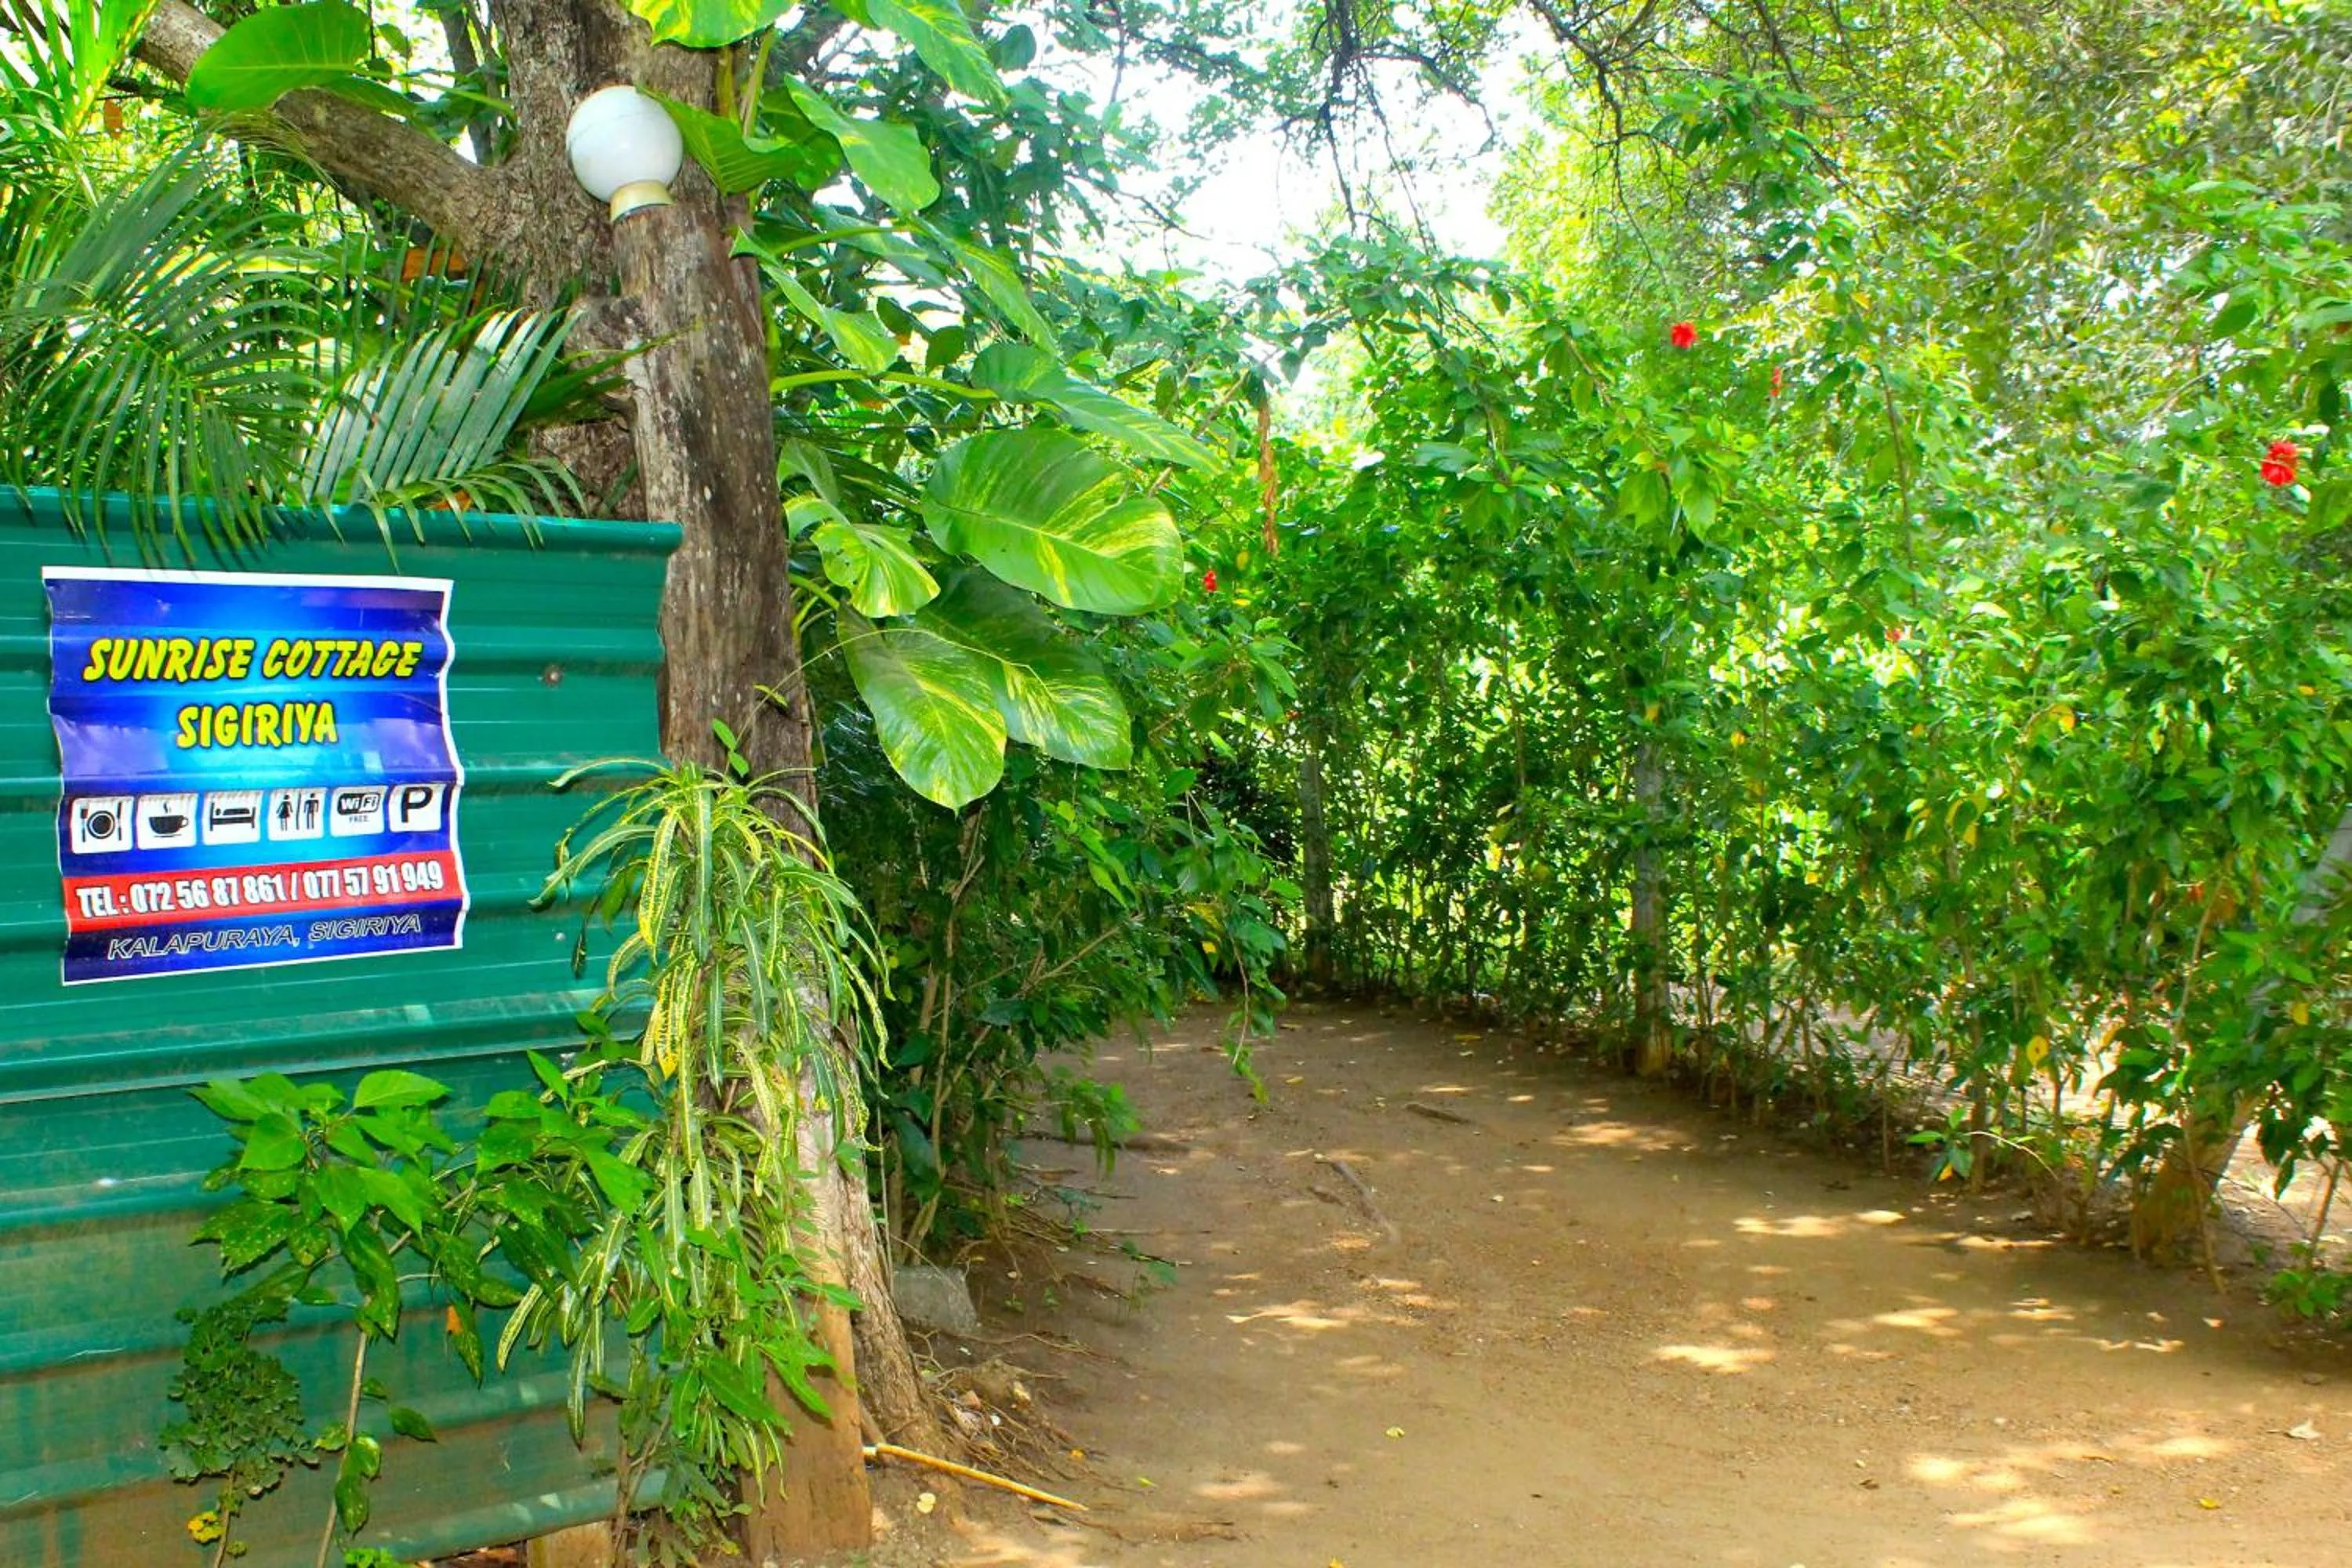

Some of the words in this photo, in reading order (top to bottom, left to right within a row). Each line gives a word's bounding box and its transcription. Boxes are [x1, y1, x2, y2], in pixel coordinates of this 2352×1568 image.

[83, 638, 253, 682] SUNRISE
[262, 639, 422, 678] COTTAGE
[176, 702, 337, 748] SIGIRIYA
[401, 787, 433, 823] P
[129, 882, 176, 913] 072
[176, 879, 209, 909] 56
[211, 877, 240, 906] 87
[242, 873, 287, 903] 861
[303, 869, 340, 899] 077
[343, 866, 369, 896] 57
[372, 863, 401, 895] 91
[401, 860, 444, 891] 949
[107, 924, 300, 960] KALAPURAYA,
[308, 913, 421, 942] SIGIRIYA
